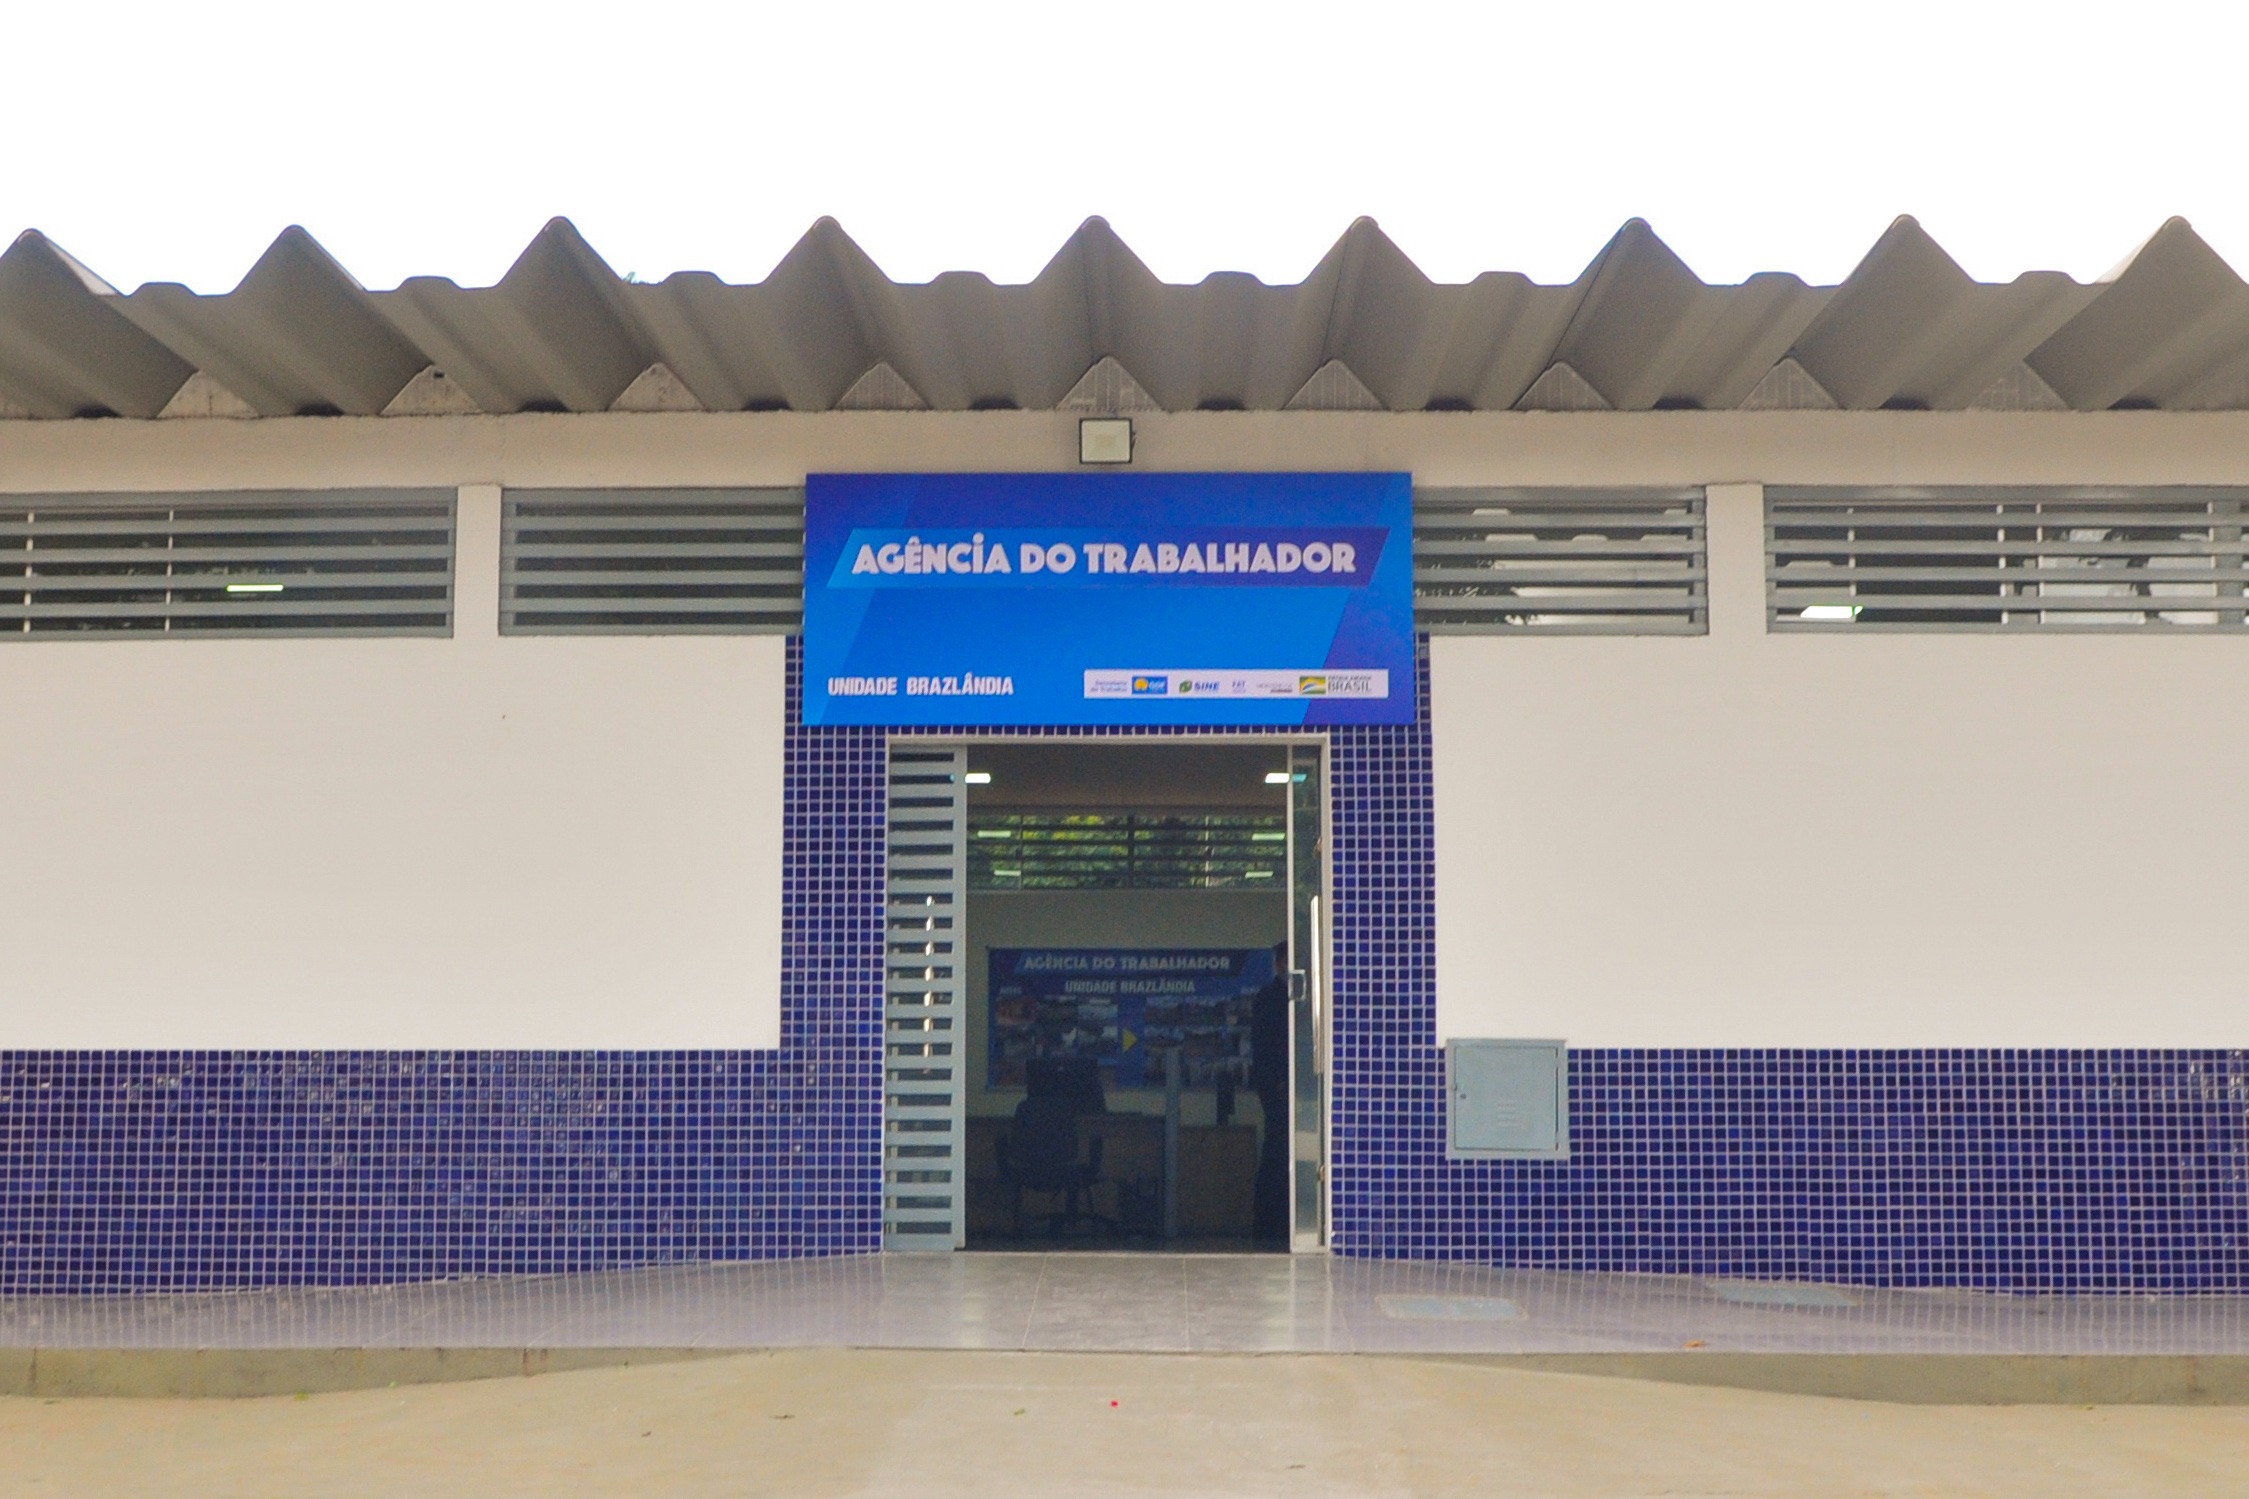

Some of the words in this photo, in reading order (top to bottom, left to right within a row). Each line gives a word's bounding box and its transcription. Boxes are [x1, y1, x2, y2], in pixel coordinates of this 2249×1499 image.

[1020, 543, 1076, 573] DO
[1083, 542, 1356, 573] TRABALHADOR
[828, 677, 898, 696] UNIDADE
[906, 672, 1014, 695] BRAZLÂNDIA
[1194, 680, 1219, 690] SINE
[1328, 681, 1372, 692] BRASIL
[1092, 957, 1116, 970] DO
[1120, 956, 1231, 970] TRABALHADOR
[1064, 979, 1117, 993] UNIDADE
[1120, 976, 1196, 993] BRAZLÂNDIA
